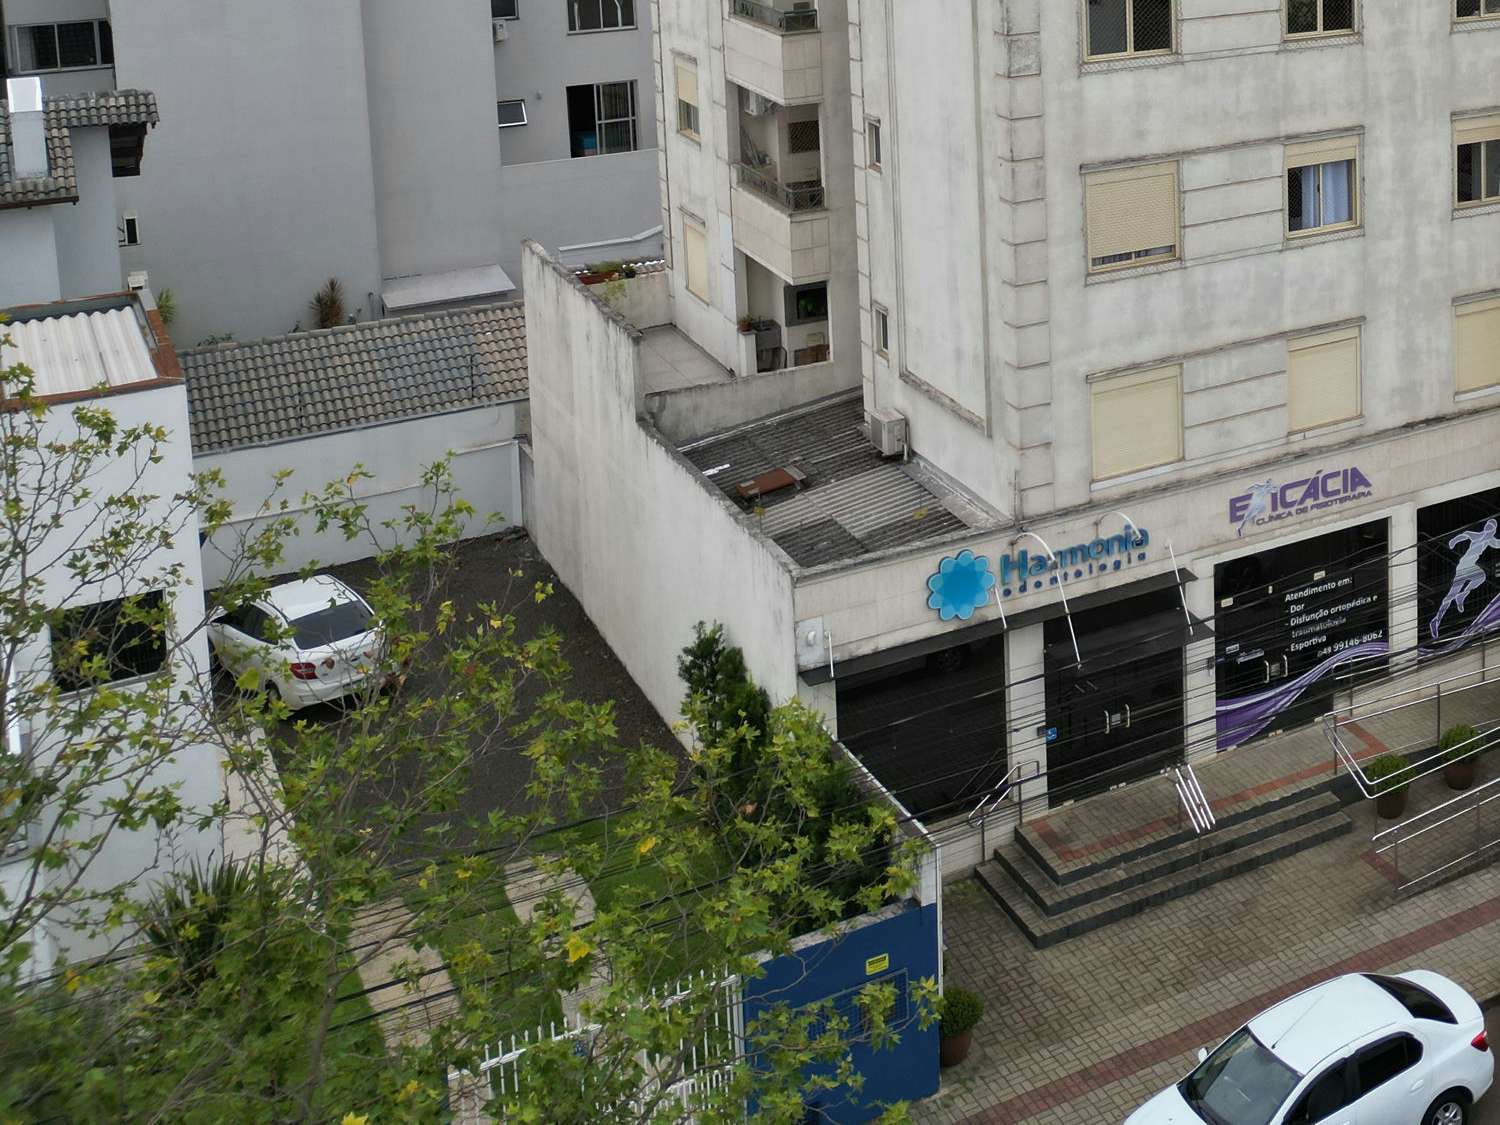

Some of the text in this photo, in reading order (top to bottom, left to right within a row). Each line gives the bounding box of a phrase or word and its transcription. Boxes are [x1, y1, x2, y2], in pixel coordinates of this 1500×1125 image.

[1229, 466, 1373, 524] EICÁCIA
[1256, 511, 1293, 526] CLÍNICA
[1295, 506, 1309, 515] DE
[1310, 490, 1372, 511] FISIOTERAPIA
[1001, 525, 1149, 586] Harmonia
[1003, 552, 1146, 597] odontologia
[1284, 577, 1353, 602] Atendimento em:
[1290, 603, 1305, 613] Dor
[1290, 609, 1328, 626] Disfunção
[1330, 596, 1372, 614] ortopédica
[1290, 635, 1327, 652] Esportiva
